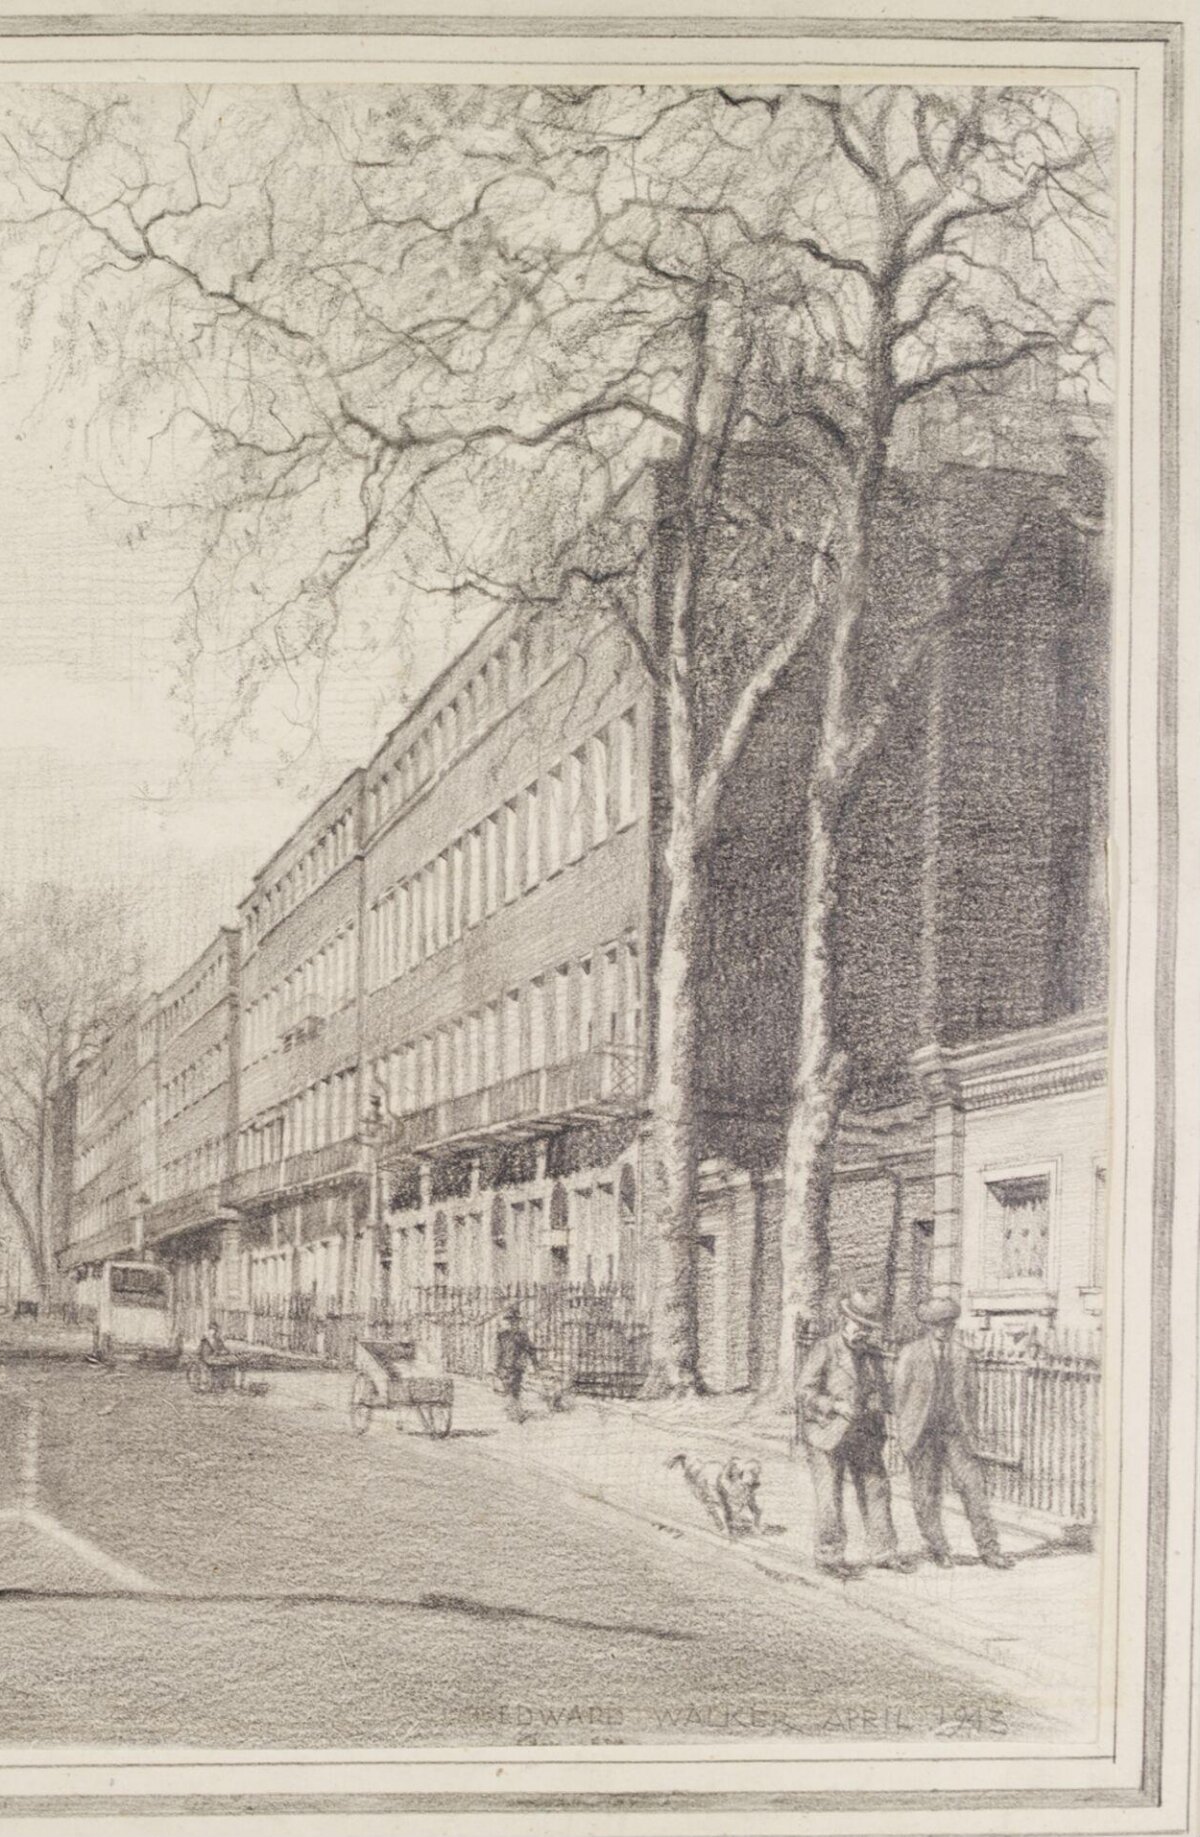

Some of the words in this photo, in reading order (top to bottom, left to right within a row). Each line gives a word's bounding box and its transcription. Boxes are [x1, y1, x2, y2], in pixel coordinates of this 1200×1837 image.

[497, 1704, 625, 1727] EDWARD
[653, 1704, 800, 1733] WALKER
[820, 1705, 913, 1732] APRIL
